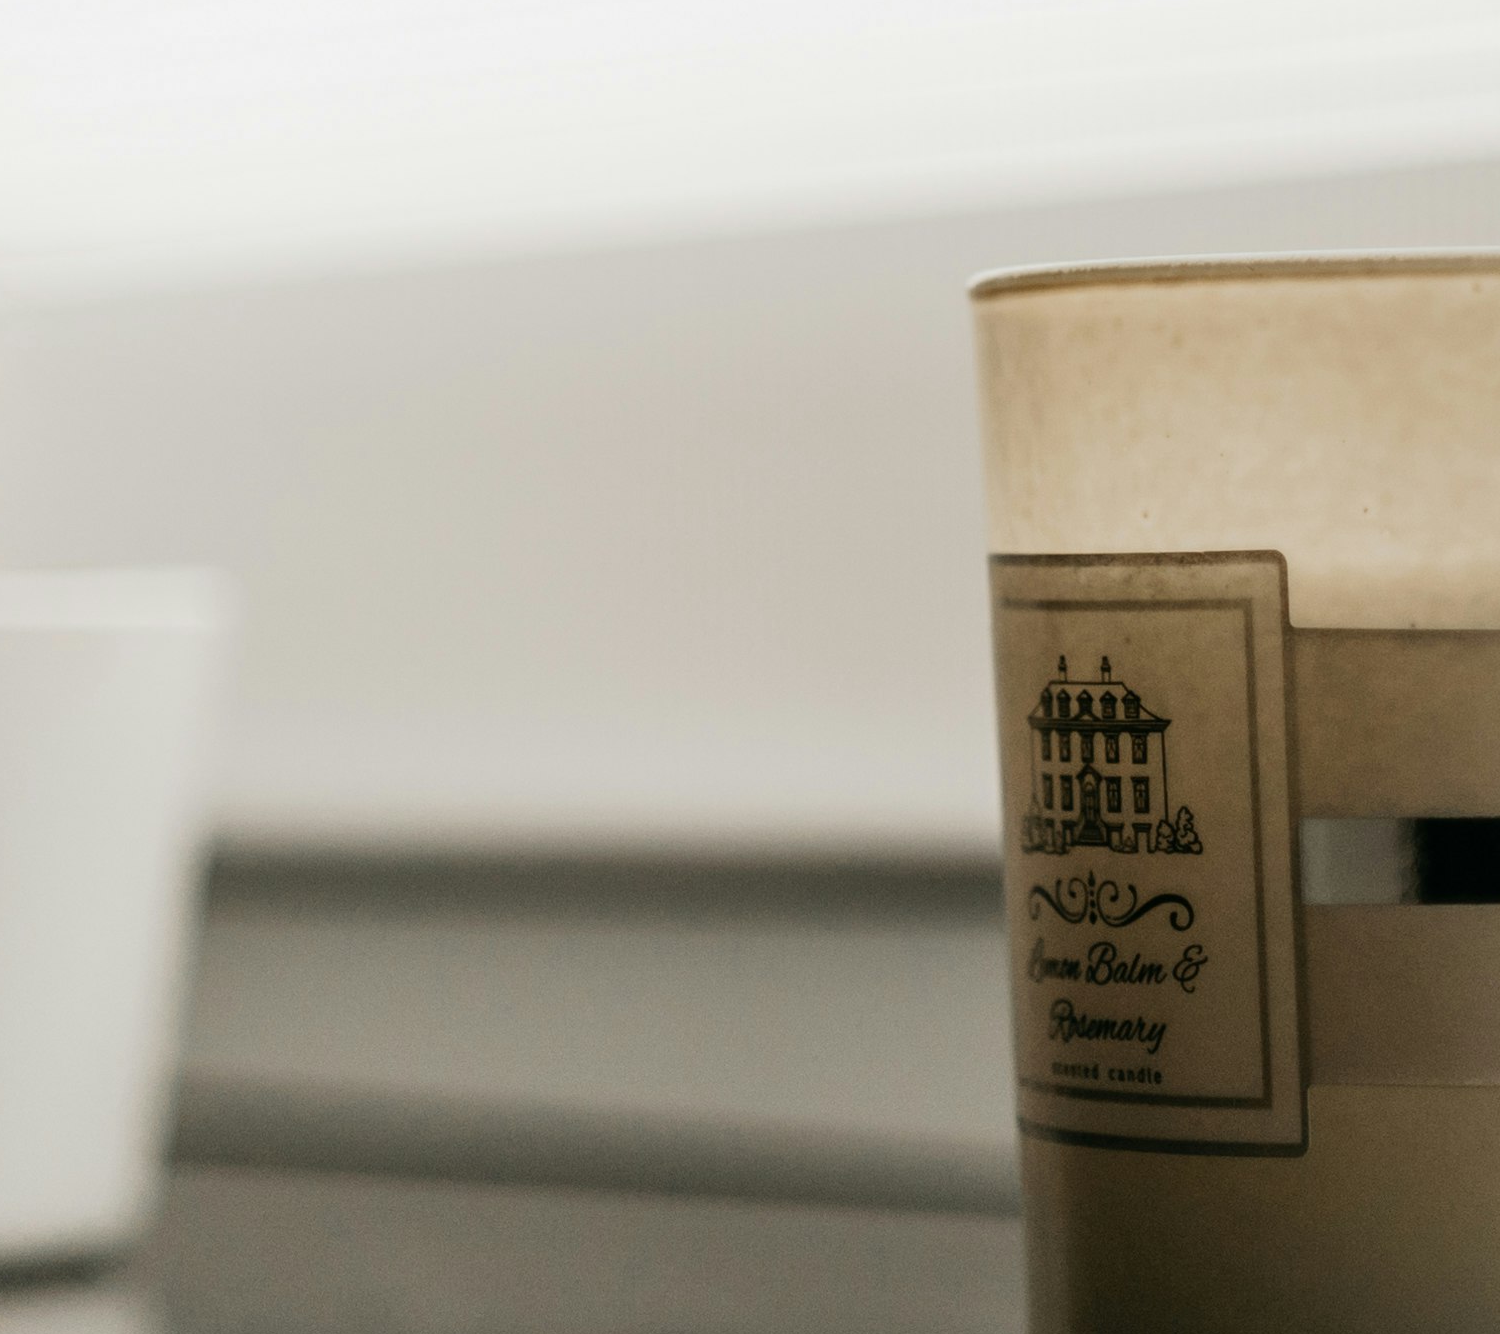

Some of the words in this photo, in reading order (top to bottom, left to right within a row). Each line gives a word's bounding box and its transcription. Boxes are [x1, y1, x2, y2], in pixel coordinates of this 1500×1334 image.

[1086, 941, 1167, 985] Balm
[1172, 944, 1208, 993] &
[1049, 999, 1167, 1054] Rosemary
[1108, 1067, 1163, 1085] candle
